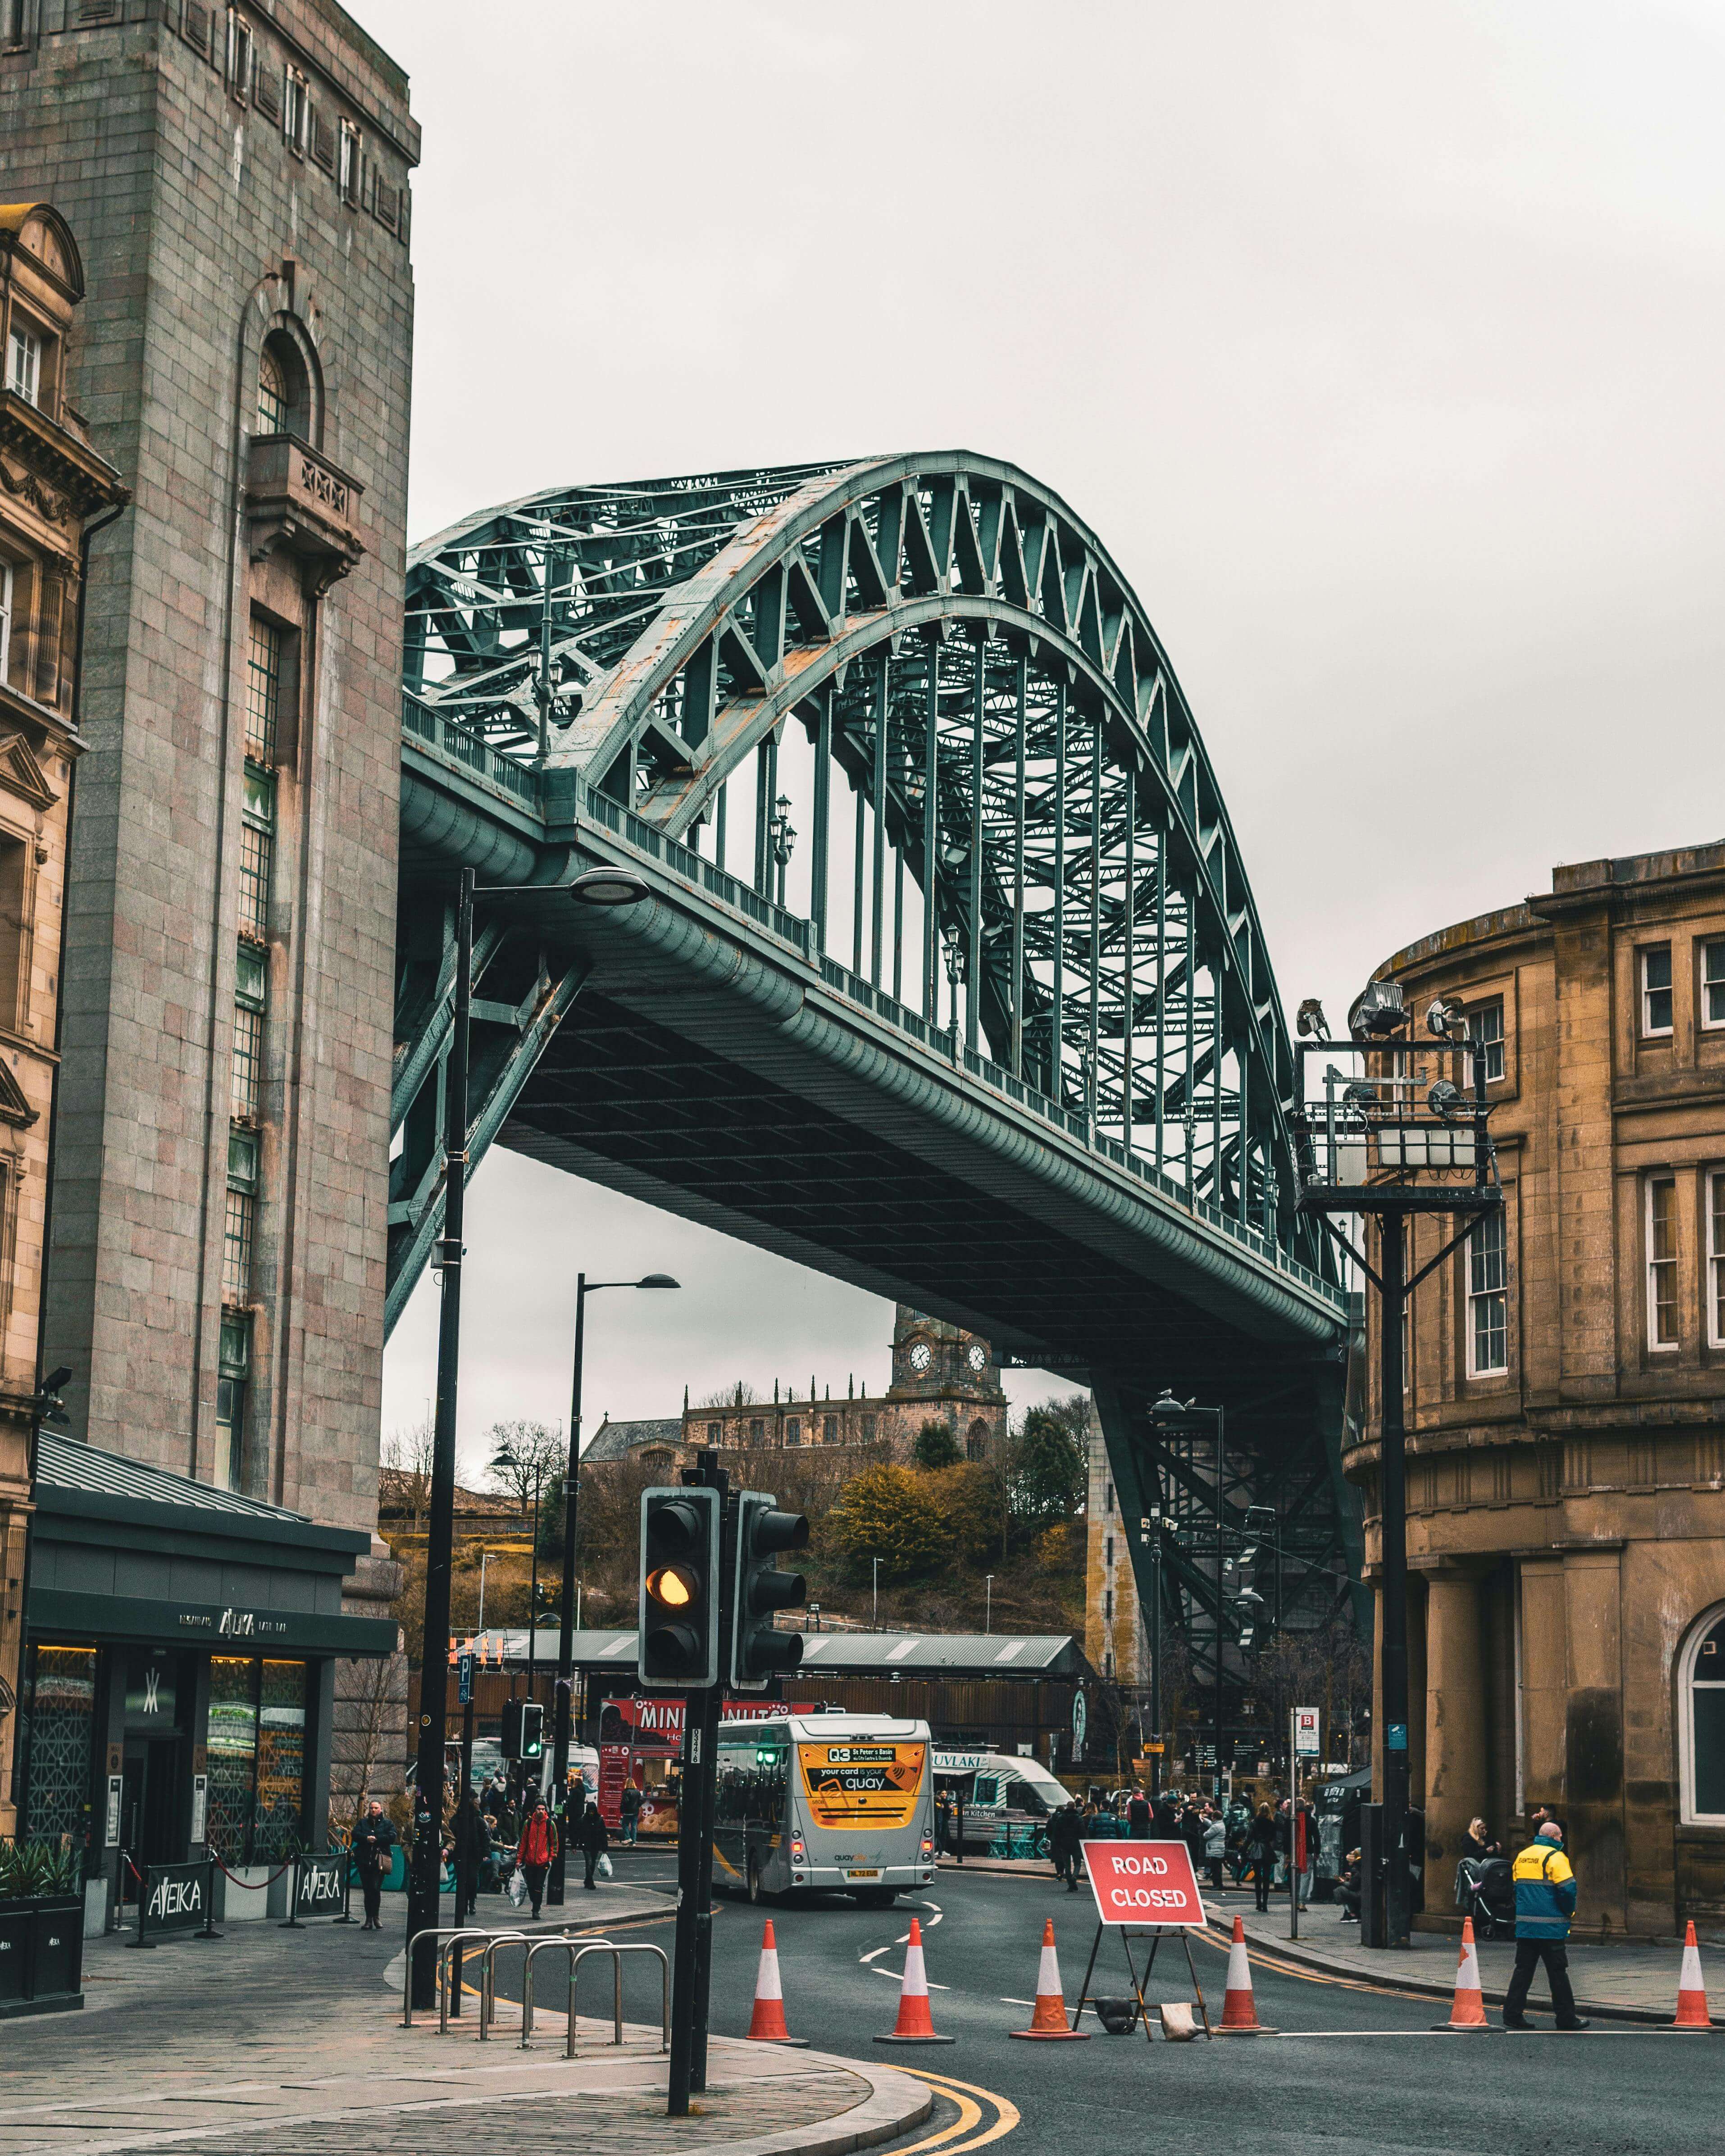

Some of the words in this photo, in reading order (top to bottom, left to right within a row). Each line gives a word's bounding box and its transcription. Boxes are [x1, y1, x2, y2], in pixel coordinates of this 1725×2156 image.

[462, 1659, 469, 1682] P
[640, 1706, 686, 1728] MINI
[1303, 1715, 1311, 1725] B
[829, 1748, 850, 1762] Q3
[932, 1755, 980, 1767] UVLAKI
[846, 1778, 884, 1791] quay
[1111, 1856, 1168, 1874] ROAD
[1111, 1889, 1187, 1907] CLOSED
